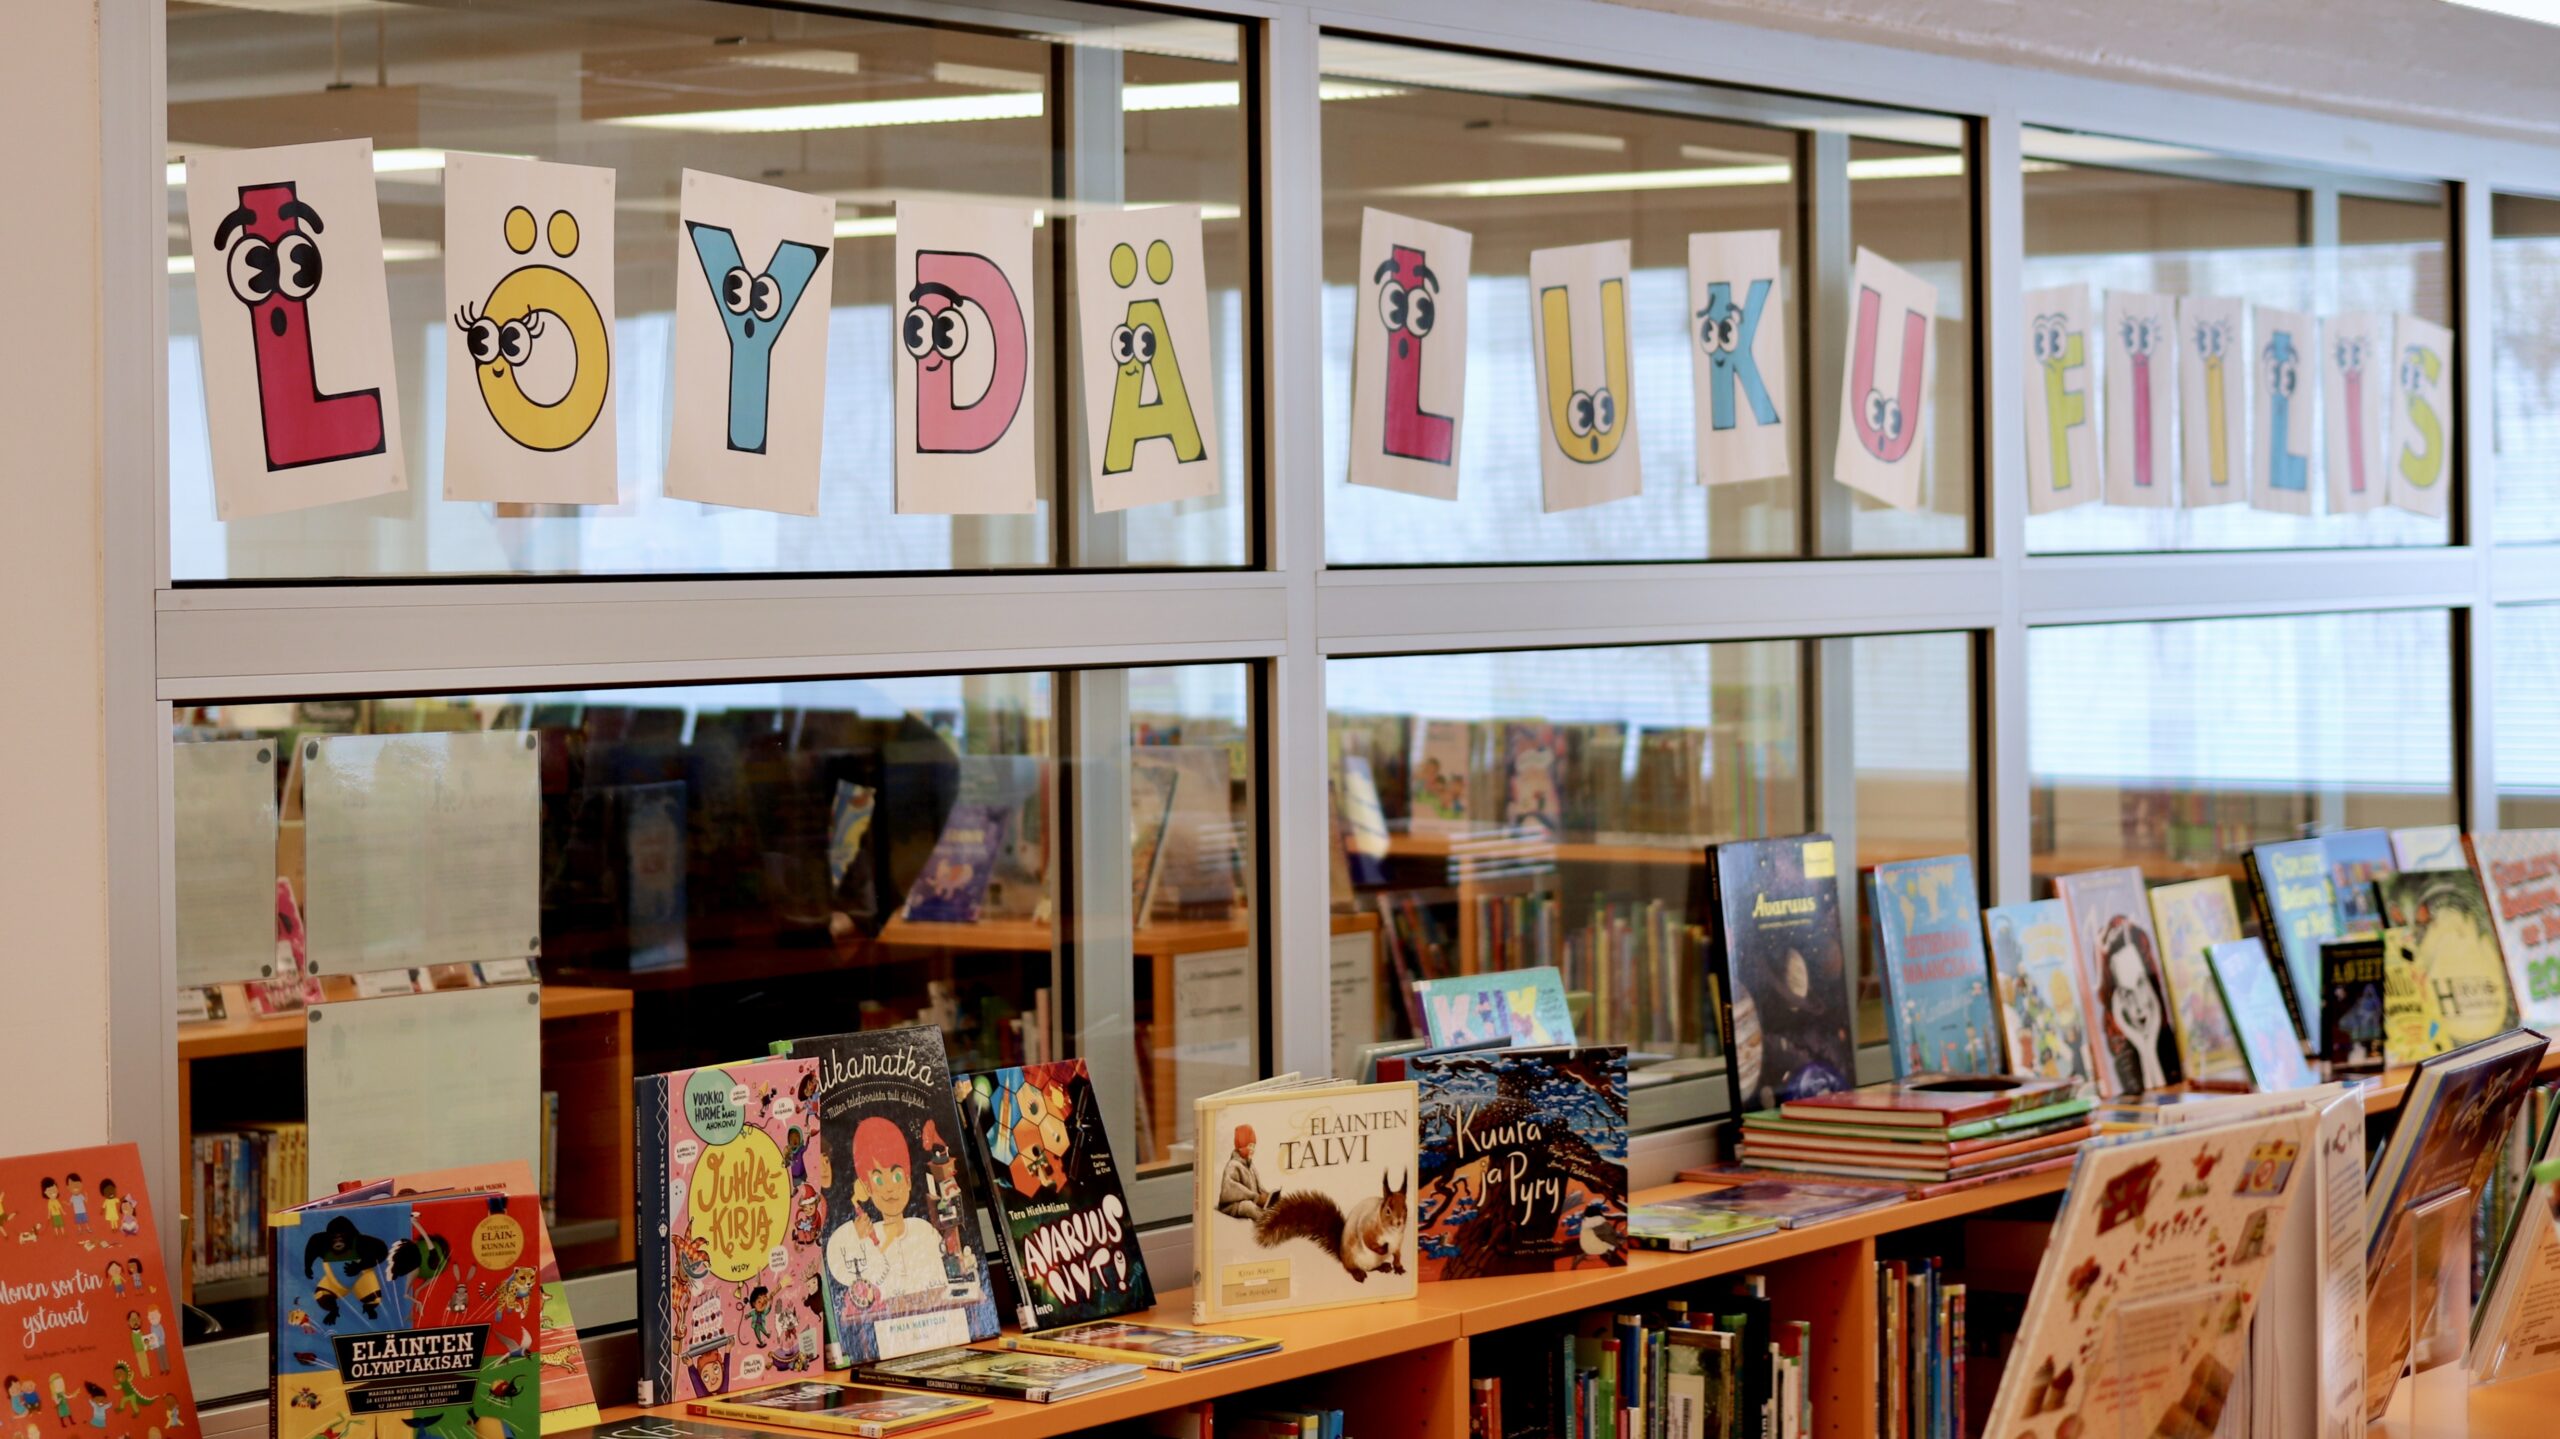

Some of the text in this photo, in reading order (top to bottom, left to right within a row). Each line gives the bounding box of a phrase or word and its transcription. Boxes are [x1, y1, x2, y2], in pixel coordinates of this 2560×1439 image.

[1751, 892, 1817, 919] Avaruus
[819, 1045, 935, 1095] ikamatka
[692, 1090, 724, 1105] VUOKKO
[694, 1106, 721, 1124] HURME
[721, 1110, 737, 1119] MARI
[705, 1120, 737, 1131] AHOKOIVU
[1456, 1103, 1542, 1159] Kuura
[1279, 1134, 1371, 1170] TALVI
[697, 1147, 782, 1213] JUHLA-
[1477, 1151, 1560, 1226] ja Pyry
[1008, 1202, 1070, 1221] Tero Hiekkalinna
[481, 1230, 517, 1242] ELÄIN-
[481, 1241, 516, 1251] KUNNAN
[709, 1205, 773, 1259] KIRJA
[1023, 1193, 1125, 1278] AVARUUS
[730, 1263, 750, 1273] WSOY
[1048, 1247, 1128, 1305] NYT!
[51, 1269, 103, 1300] sortin
[22, 1300, 89, 1349] ystävät
[1035, 1303, 1054, 1316] into
[351, 1332, 475, 1362] ELÄINTEN
[350, 1353, 475, 1379] OLYMPIAKISAT
